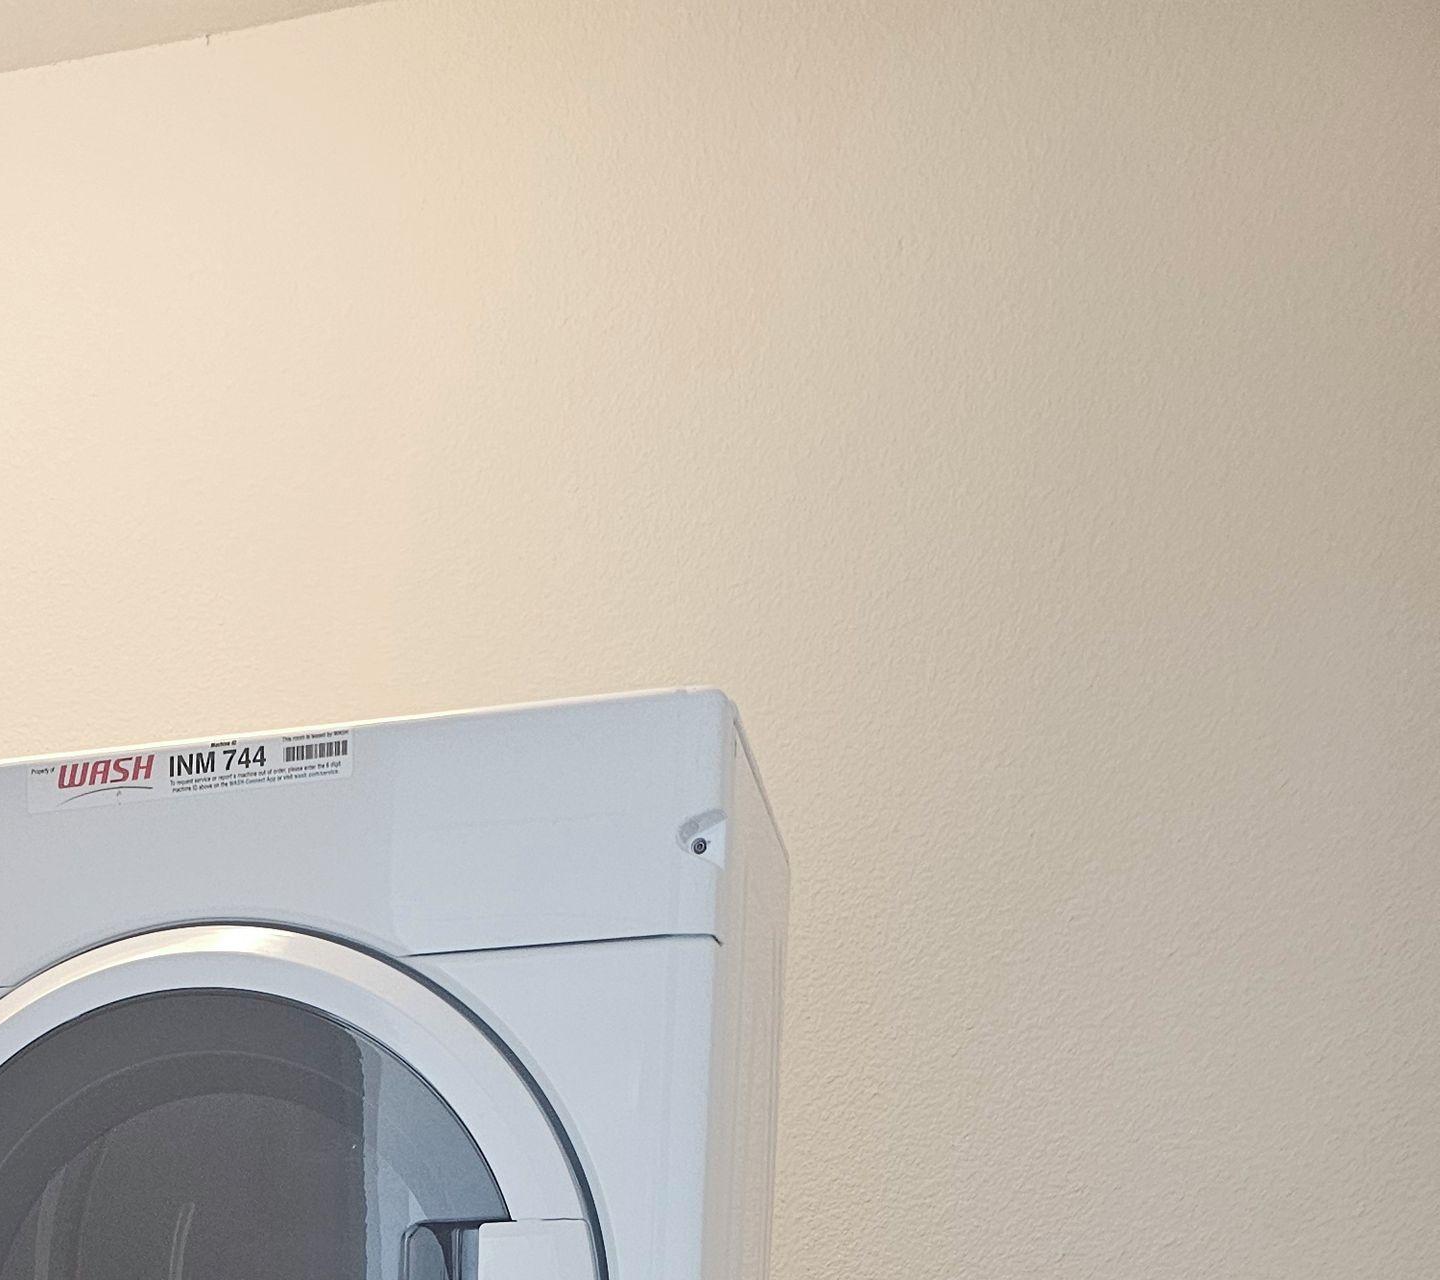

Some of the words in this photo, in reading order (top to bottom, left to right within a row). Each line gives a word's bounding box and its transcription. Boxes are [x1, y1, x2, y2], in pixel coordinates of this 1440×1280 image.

[31, 767, 48, 775] Property
[58, 755, 155, 789] WASH
[169, 751, 215, 777] INM
[223, 745, 266, 770] 744
